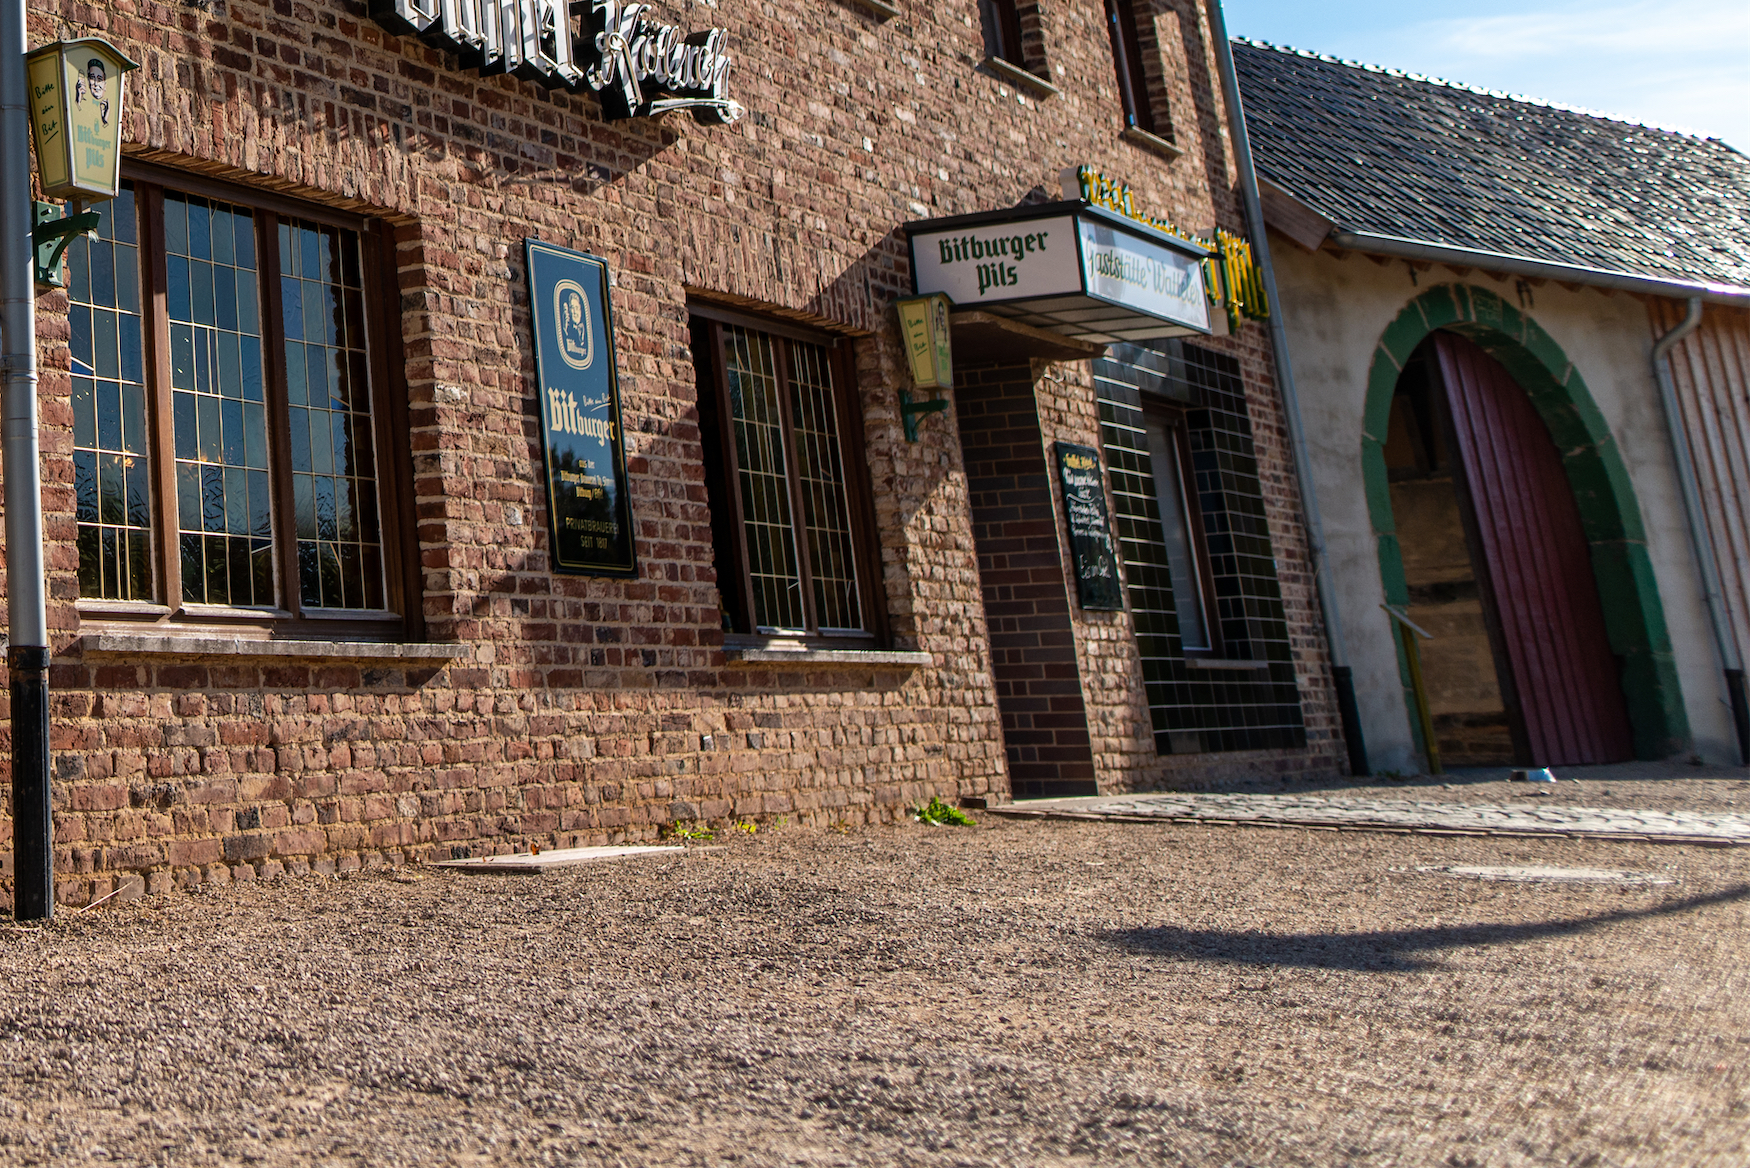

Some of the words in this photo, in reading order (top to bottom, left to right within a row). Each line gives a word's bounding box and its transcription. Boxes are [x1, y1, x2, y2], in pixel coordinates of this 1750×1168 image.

[35, 83, 55, 99] Bitte
[42, 120, 58, 135] Bit
[77, 124, 111, 150] Bitburger
[938, 231, 1049, 264] Bitburger
[1086, 234, 1148, 290] Gaststätte
[1147, 255, 1202, 307] Watteler
[547, 386, 616, 447] Bitburger
